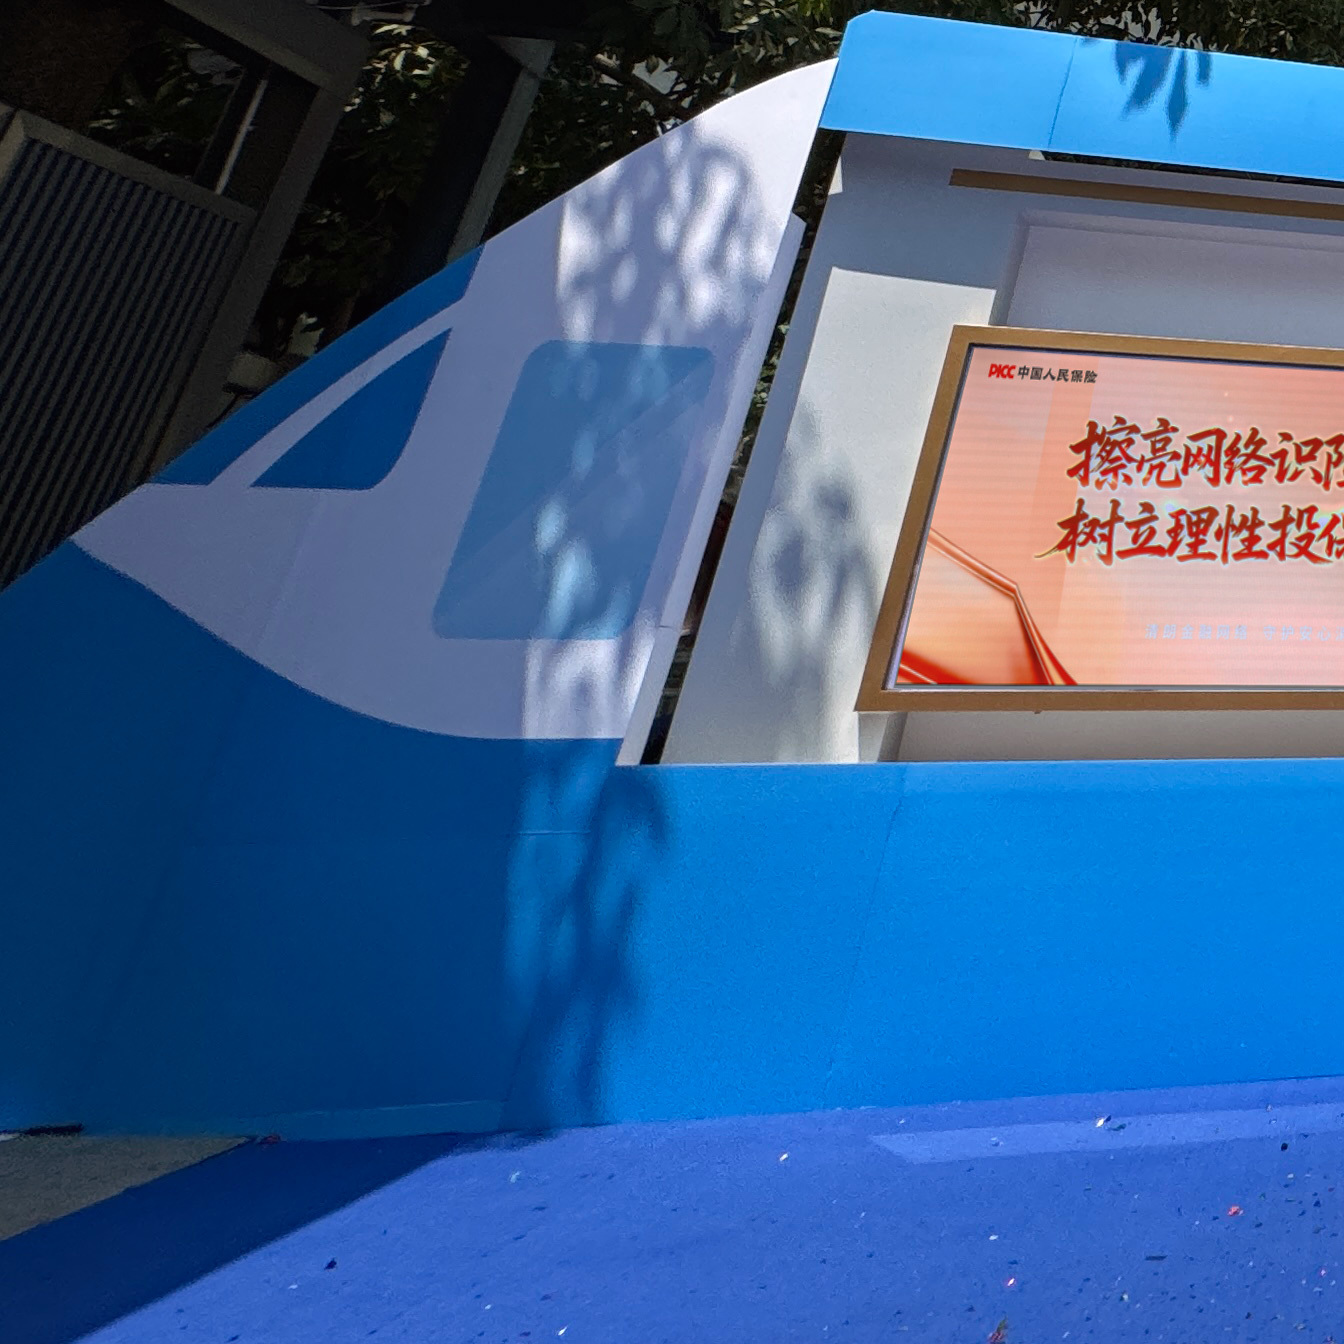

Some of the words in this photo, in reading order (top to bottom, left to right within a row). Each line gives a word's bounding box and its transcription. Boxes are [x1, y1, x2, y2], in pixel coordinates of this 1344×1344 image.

[988, 363, 1015, 380] PICC
[1017, 365, 1097, 384] 中国人民保险
